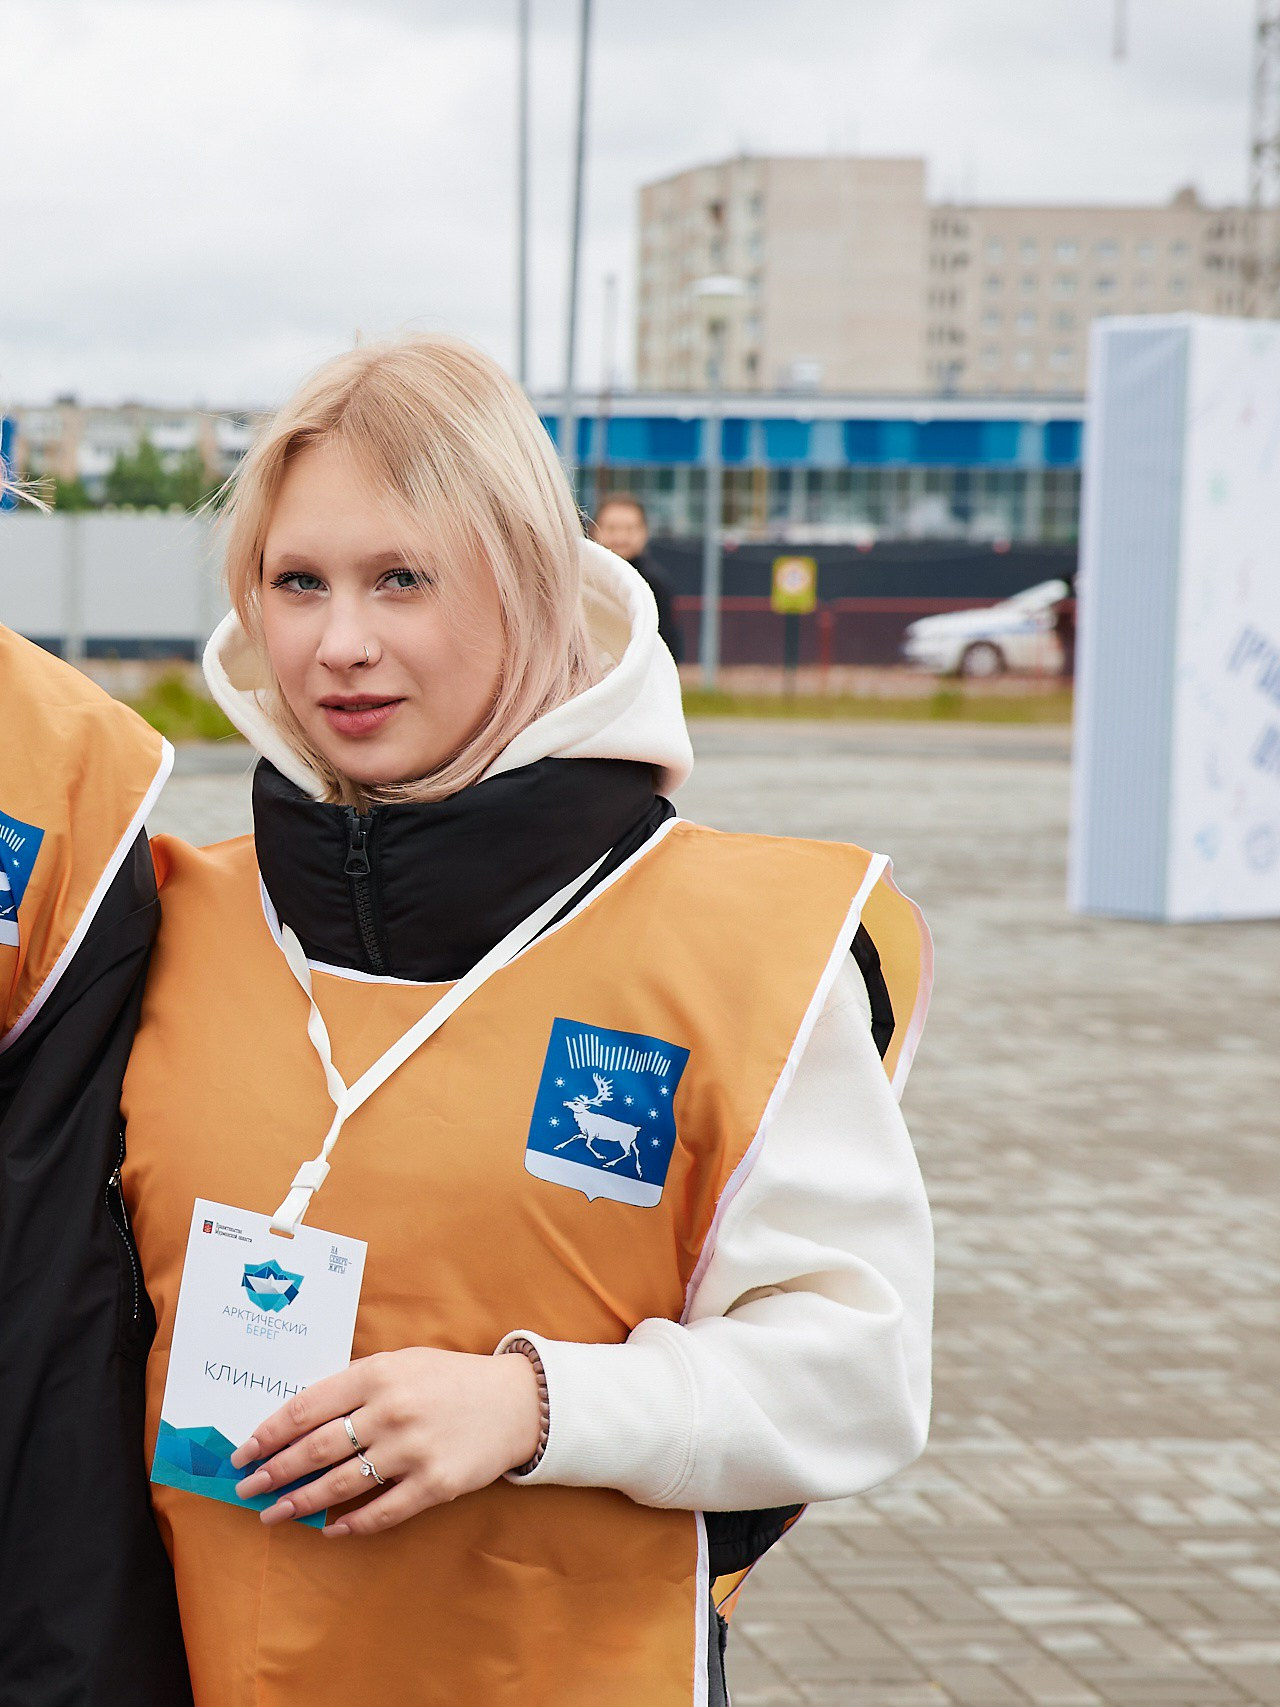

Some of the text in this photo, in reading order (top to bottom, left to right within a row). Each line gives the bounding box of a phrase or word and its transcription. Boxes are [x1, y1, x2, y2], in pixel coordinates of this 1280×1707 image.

[222, 1305, 307, 1337] АРКТИЧЕСКИЙ
[246, 1326, 279, 1341] БЕРЕГ
[205, 1360, 307, 1399] КЛИНИН
